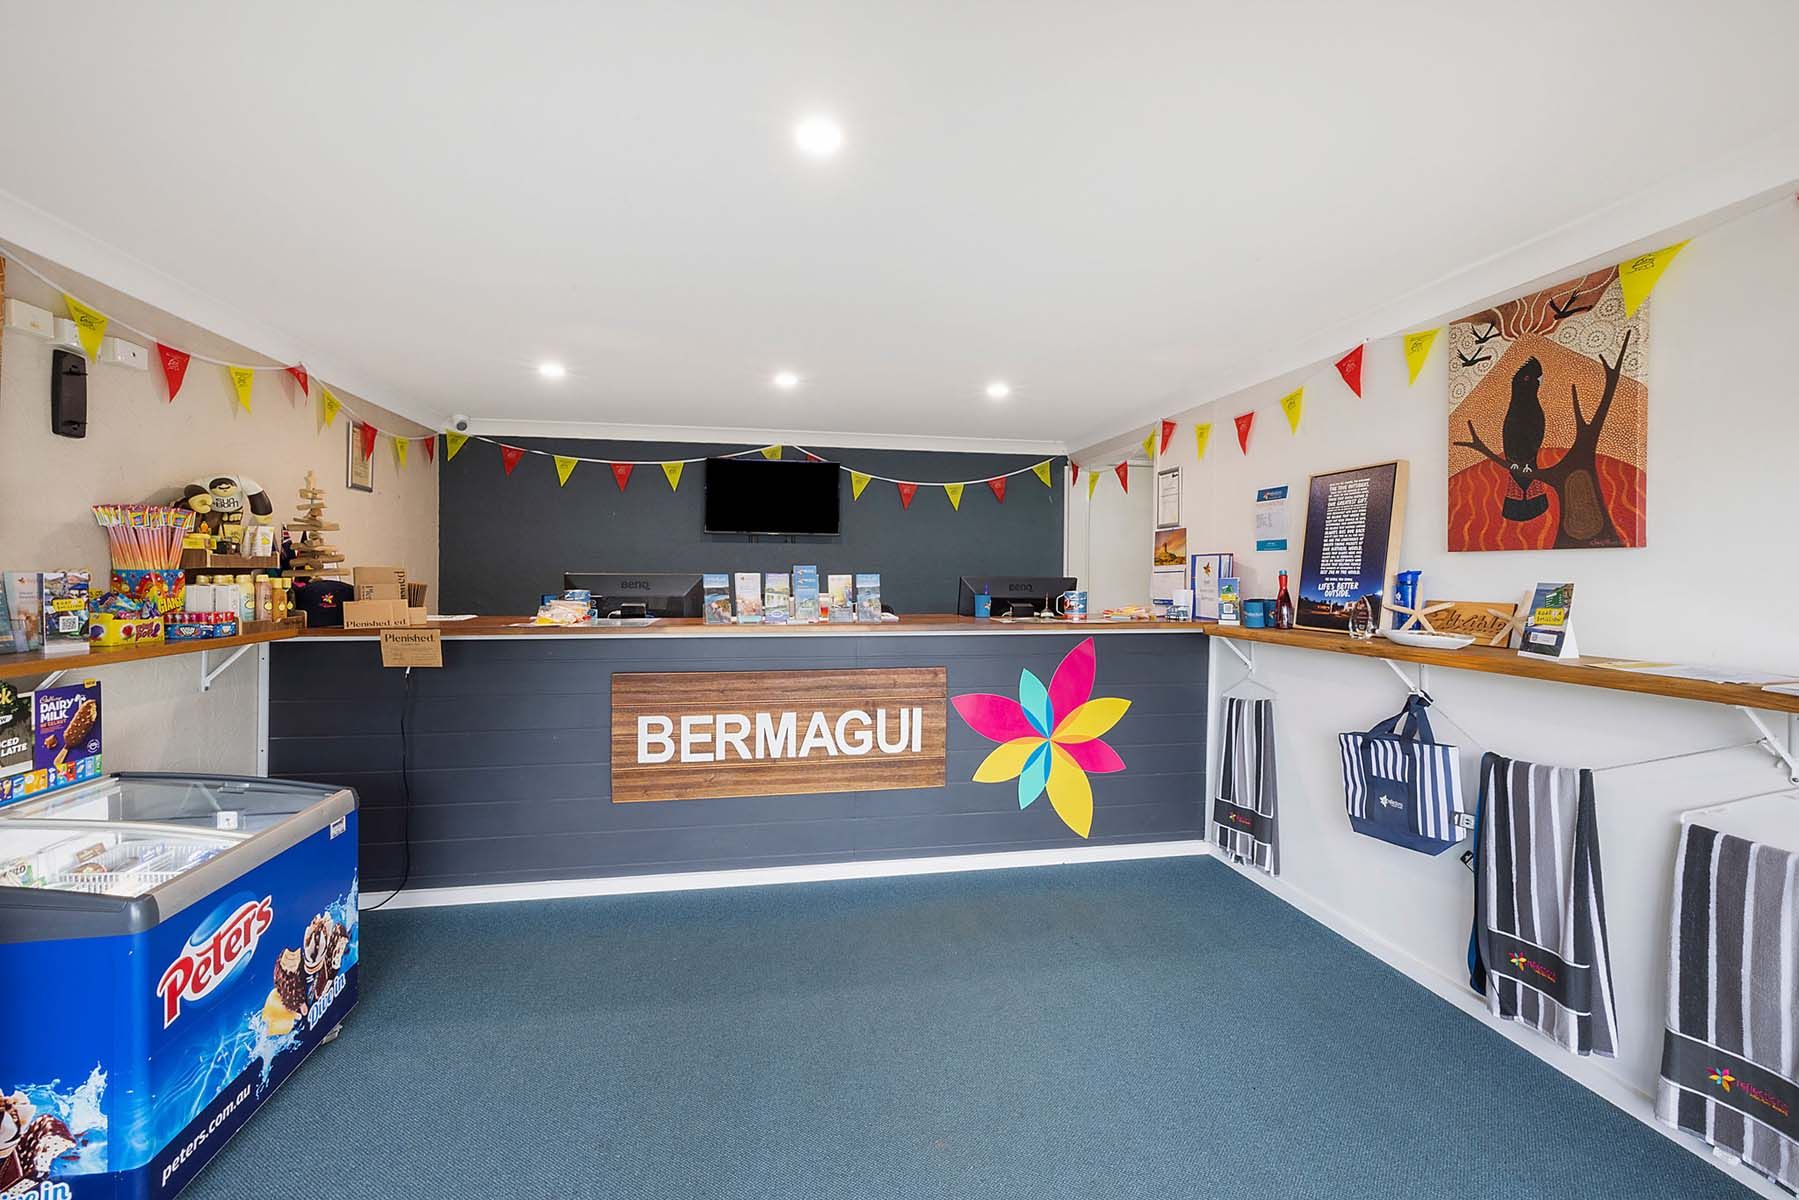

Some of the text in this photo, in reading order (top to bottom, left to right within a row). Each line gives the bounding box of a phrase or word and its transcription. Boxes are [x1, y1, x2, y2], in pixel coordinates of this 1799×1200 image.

[1336, 581, 1359, 590] BETTER
[40, 698, 74, 713] DAIRY
[40, 709, 69, 723] MILK
[0, 736, 20, 748] CED
[637, 707, 922, 764] BERMAGUI
[0, 742, 27, 757] LATTE
[158, 896, 272, 1026] Peters
[162, 1084, 251, 1187] peters.com.au
